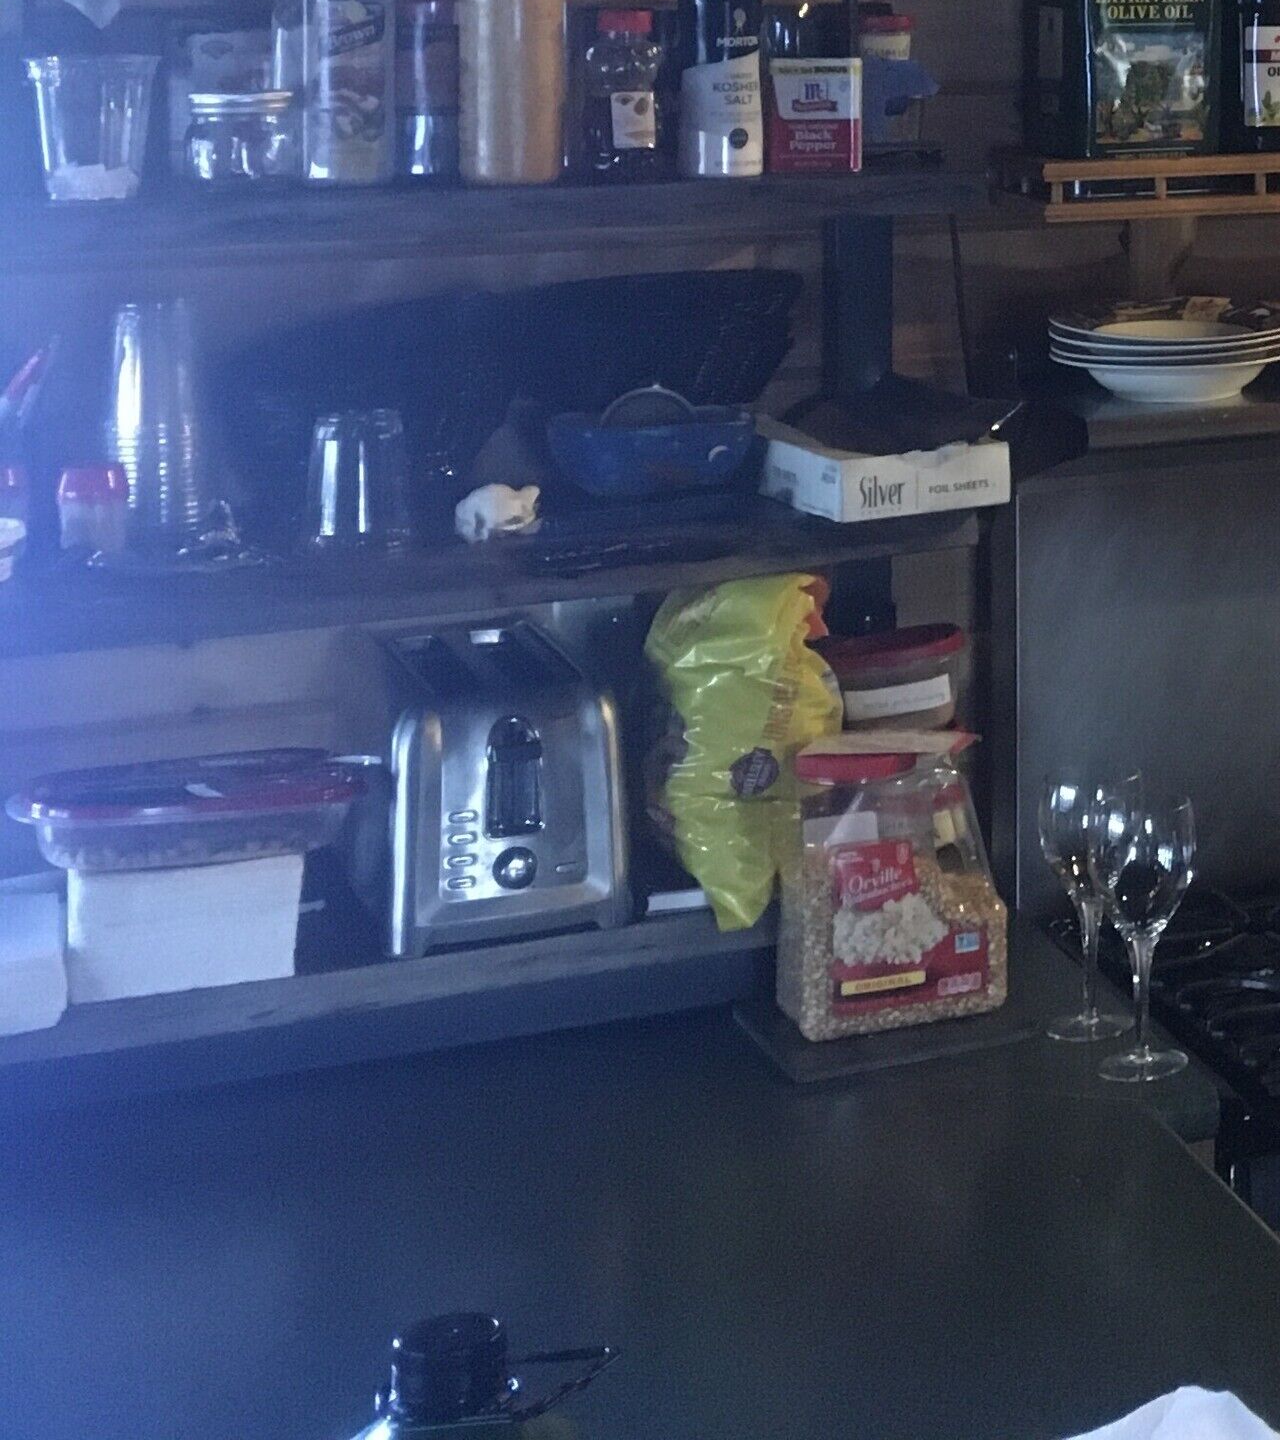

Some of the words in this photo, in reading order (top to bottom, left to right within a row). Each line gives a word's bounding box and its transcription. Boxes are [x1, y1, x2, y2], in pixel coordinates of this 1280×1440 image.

[1107, 5, 1160, 20] OLIVE
[1164, 4, 1194, 19] OIL
[723, 95, 753, 106] SALT
[859, 475, 905, 509] Silver
[928, 484, 949, 495] FOIL
[952, 478, 990, 493] SHEETS
[850, 866, 903, 896] Orville
